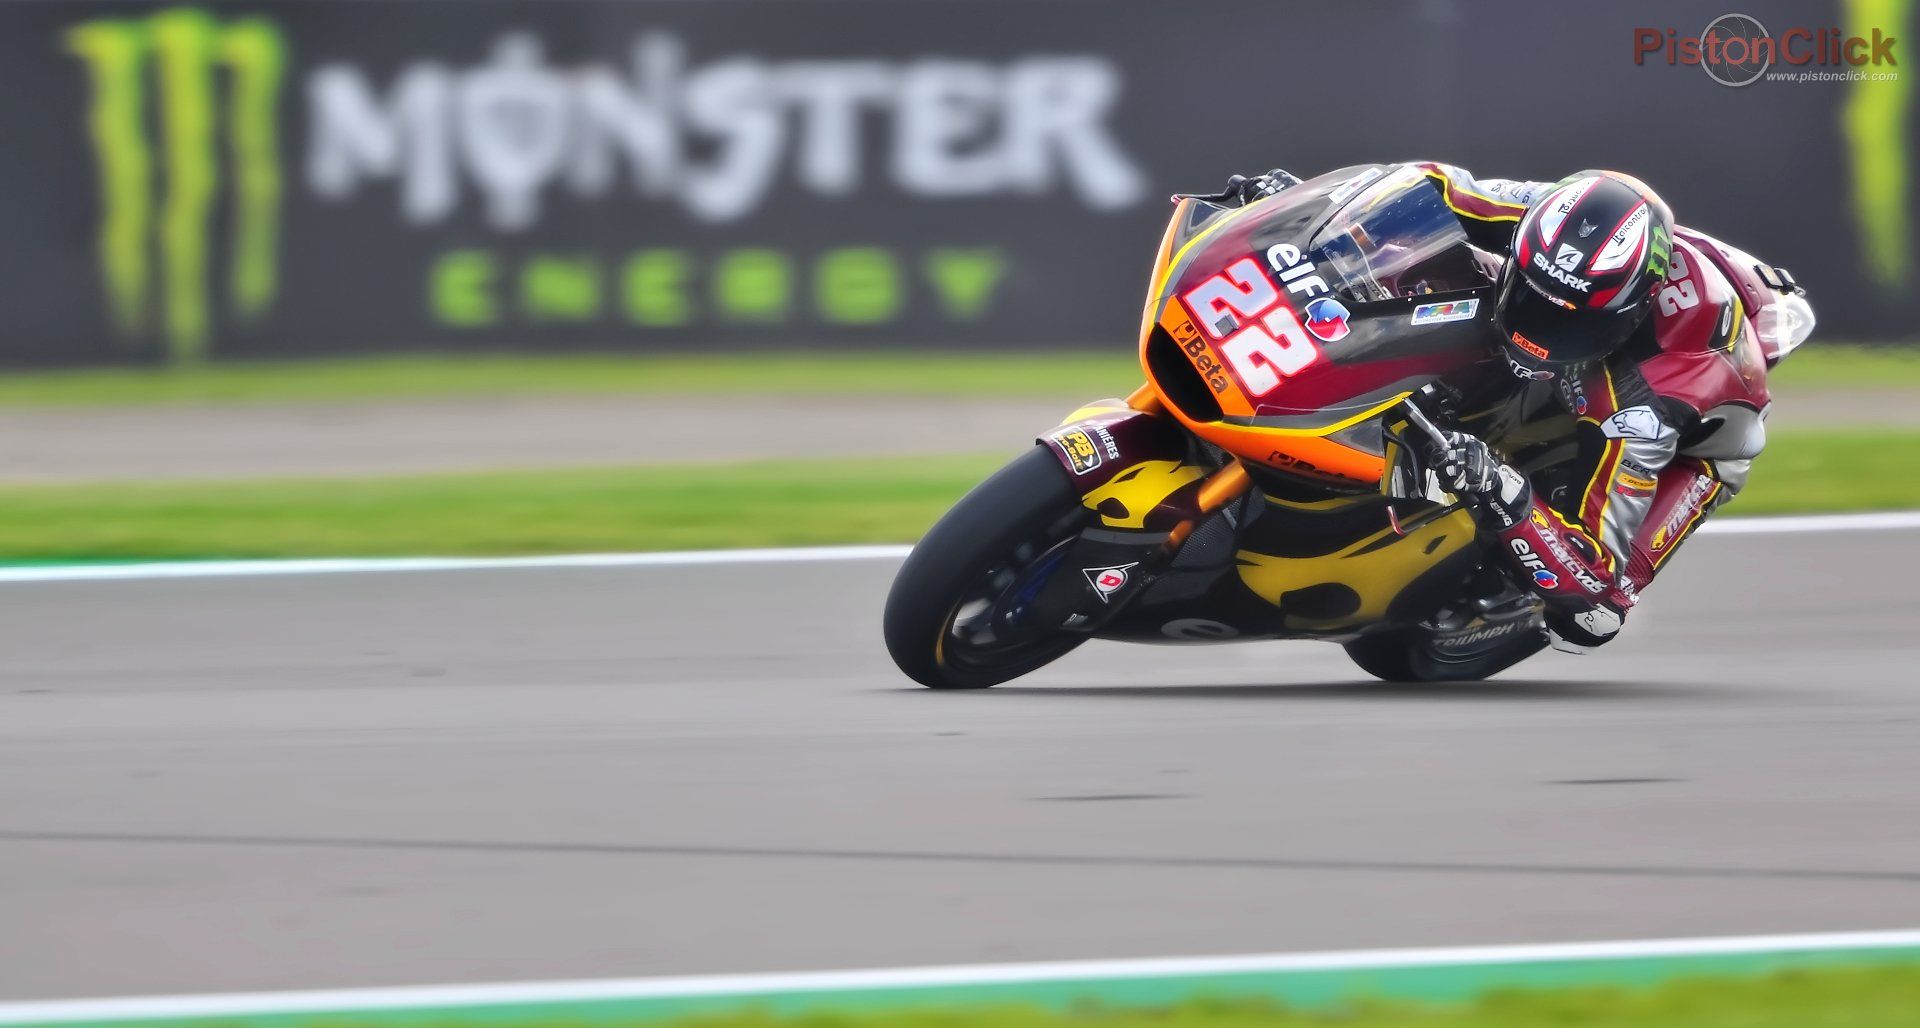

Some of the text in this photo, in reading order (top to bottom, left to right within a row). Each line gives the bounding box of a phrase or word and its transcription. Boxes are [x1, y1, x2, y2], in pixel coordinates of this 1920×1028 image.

[308, 33, 1146, 231] MONSTER
[430, 248, 1008, 327] ENERGY
[1533, 252, 1592, 293] SHARK
[1183, 256, 1320, 397] 22
[1521, 341, 1547, 358] Beta
[1184, 335, 1229, 394] Beta
[1067, 431, 1095, 458] PB
